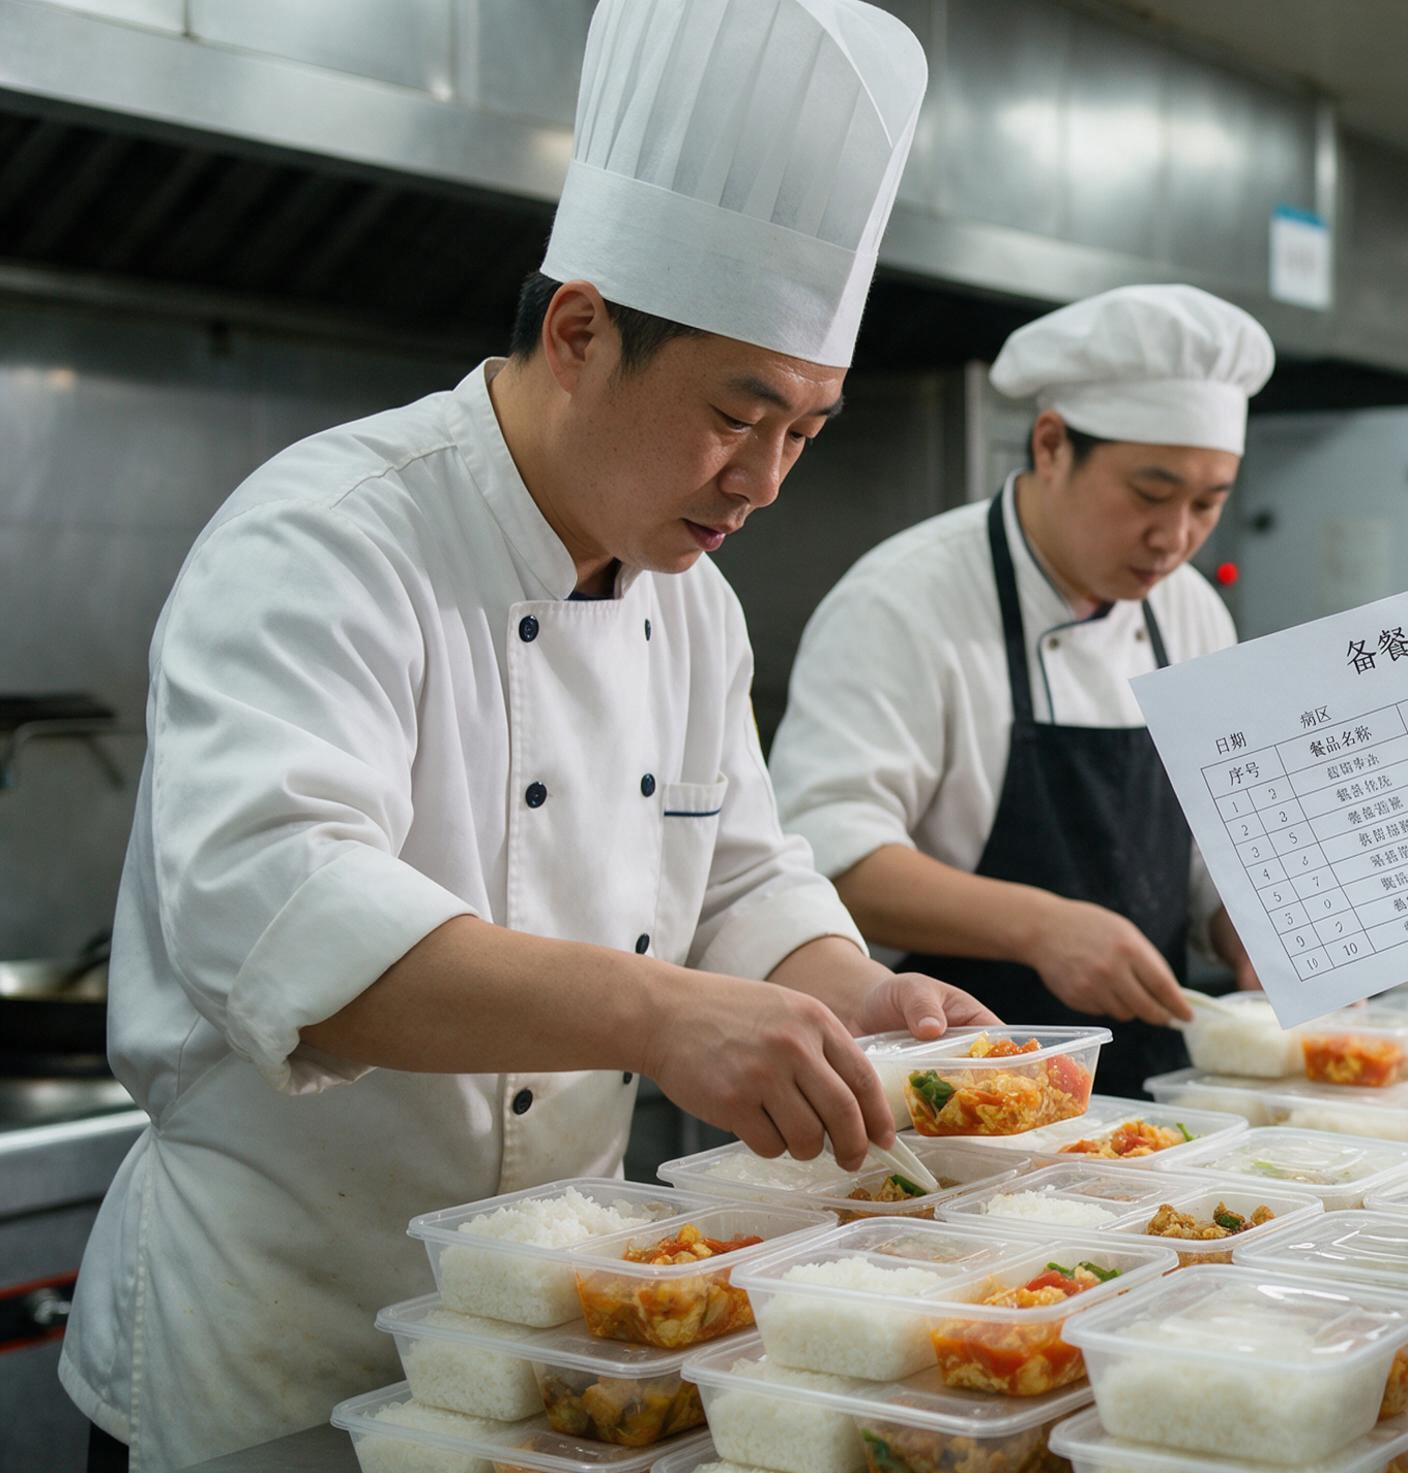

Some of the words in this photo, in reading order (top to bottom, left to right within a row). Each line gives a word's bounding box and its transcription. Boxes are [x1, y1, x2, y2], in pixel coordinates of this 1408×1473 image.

[1215, 731, 1247, 755] 日期
[1300, 704, 1332, 728] 病区
[1228, 761, 1260, 786] 序号
[1309, 725, 1373, 758] 餐品名称
[1232, 801, 1239, 813] 1
[1241, 825, 1249, 836] 2
[1289, 833, 1298, 844] 5
[1263, 868, 1271, 880] 4
[1274, 891, 1282, 902] 5
[1312, 876, 1320, 887] 7
[1343, 942, 1358, 957] 10
